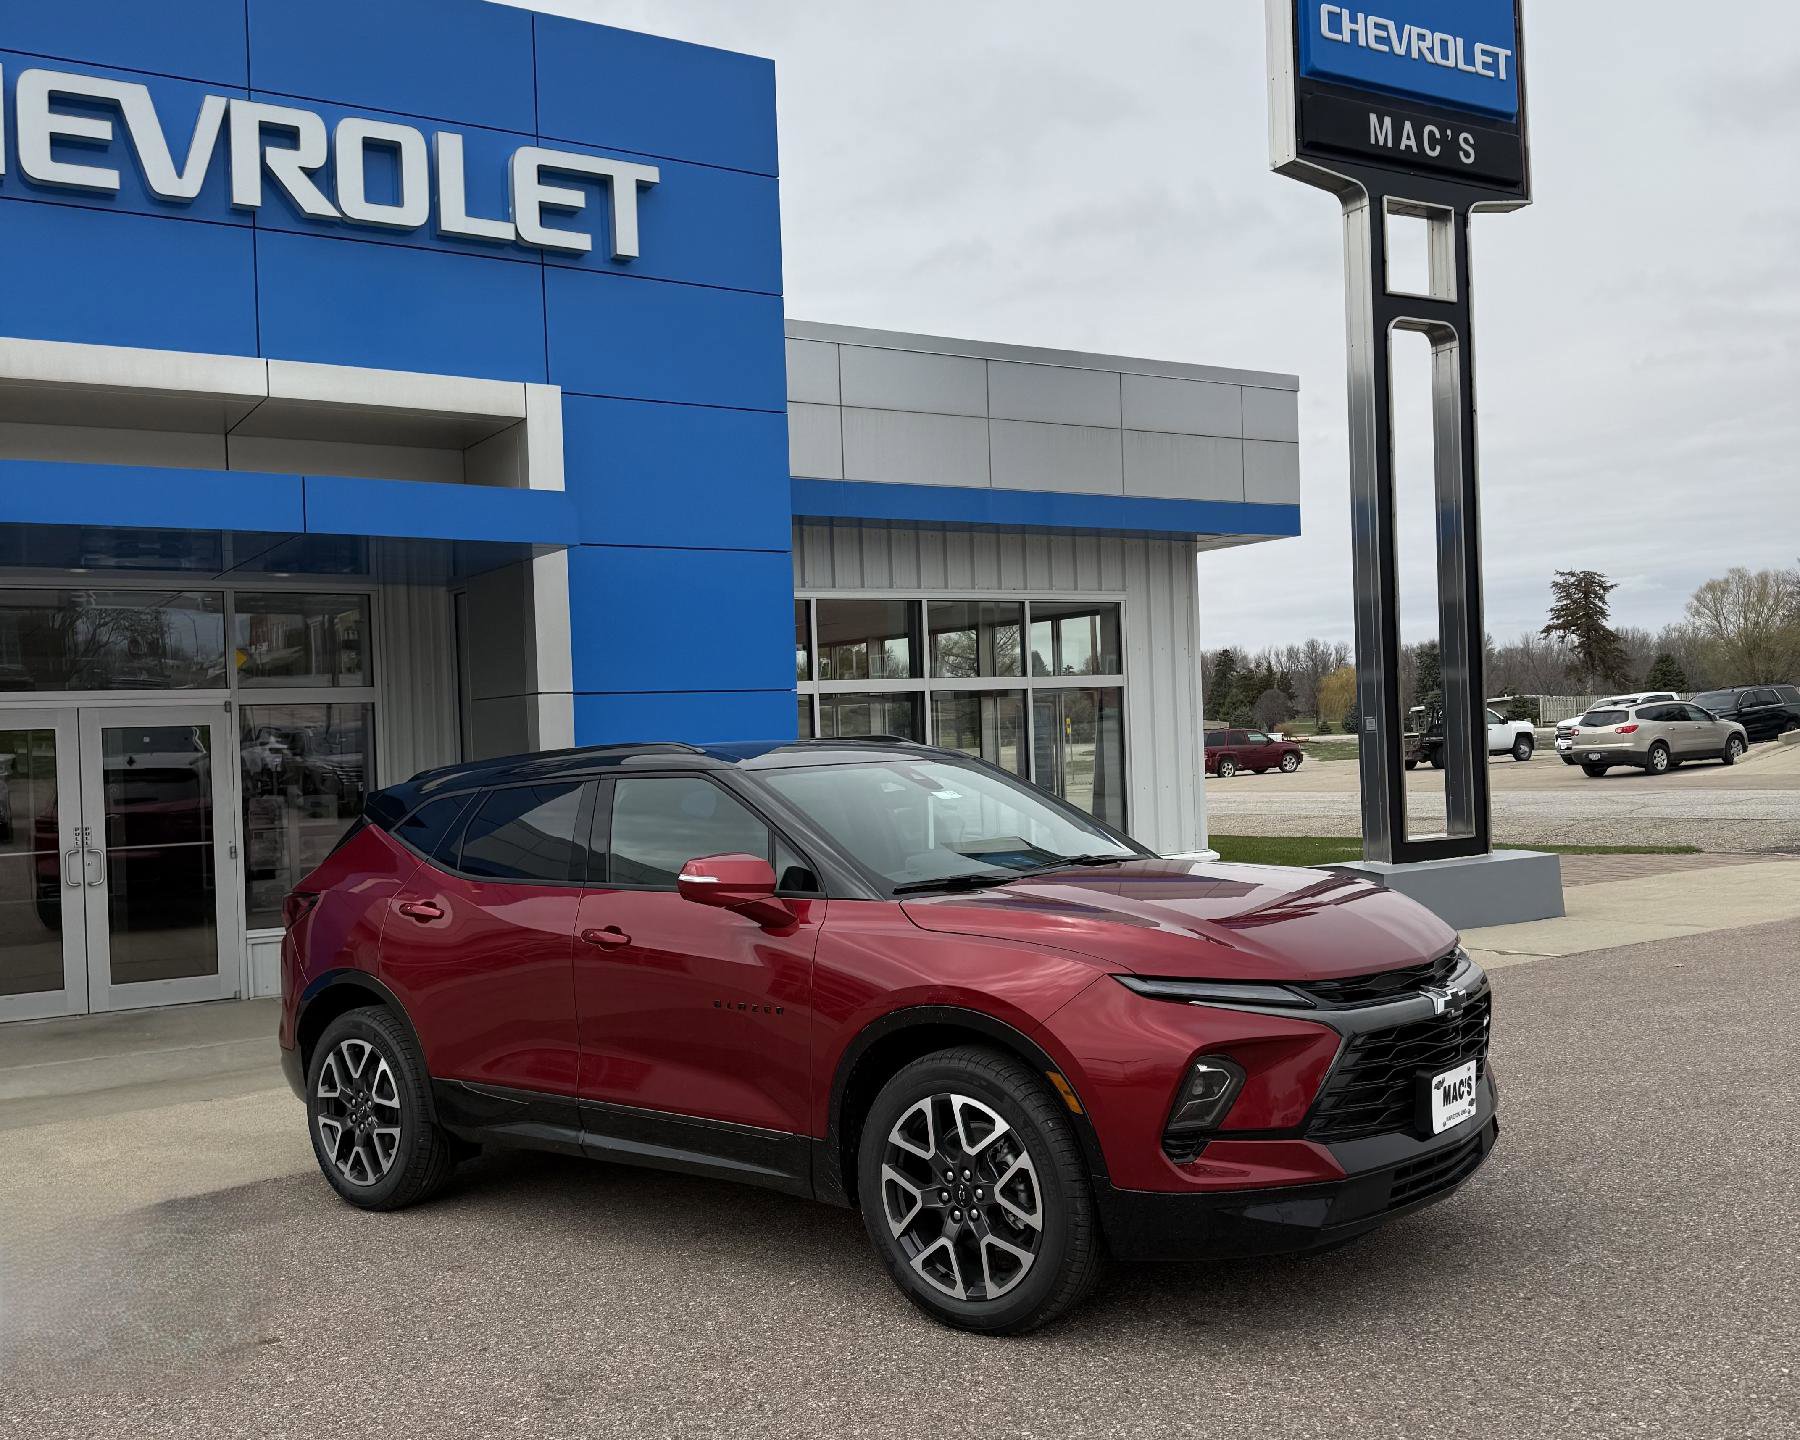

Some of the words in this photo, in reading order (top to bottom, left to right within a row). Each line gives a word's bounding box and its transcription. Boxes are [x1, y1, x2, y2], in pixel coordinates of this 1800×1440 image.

[1320, 3, 1511, 80] CHEVROLET
[0, 62, 660, 260] EVROLET
[1369, 112, 1475, 164] MAC'S
[1442, 1075, 1472, 1107] MAC'S
